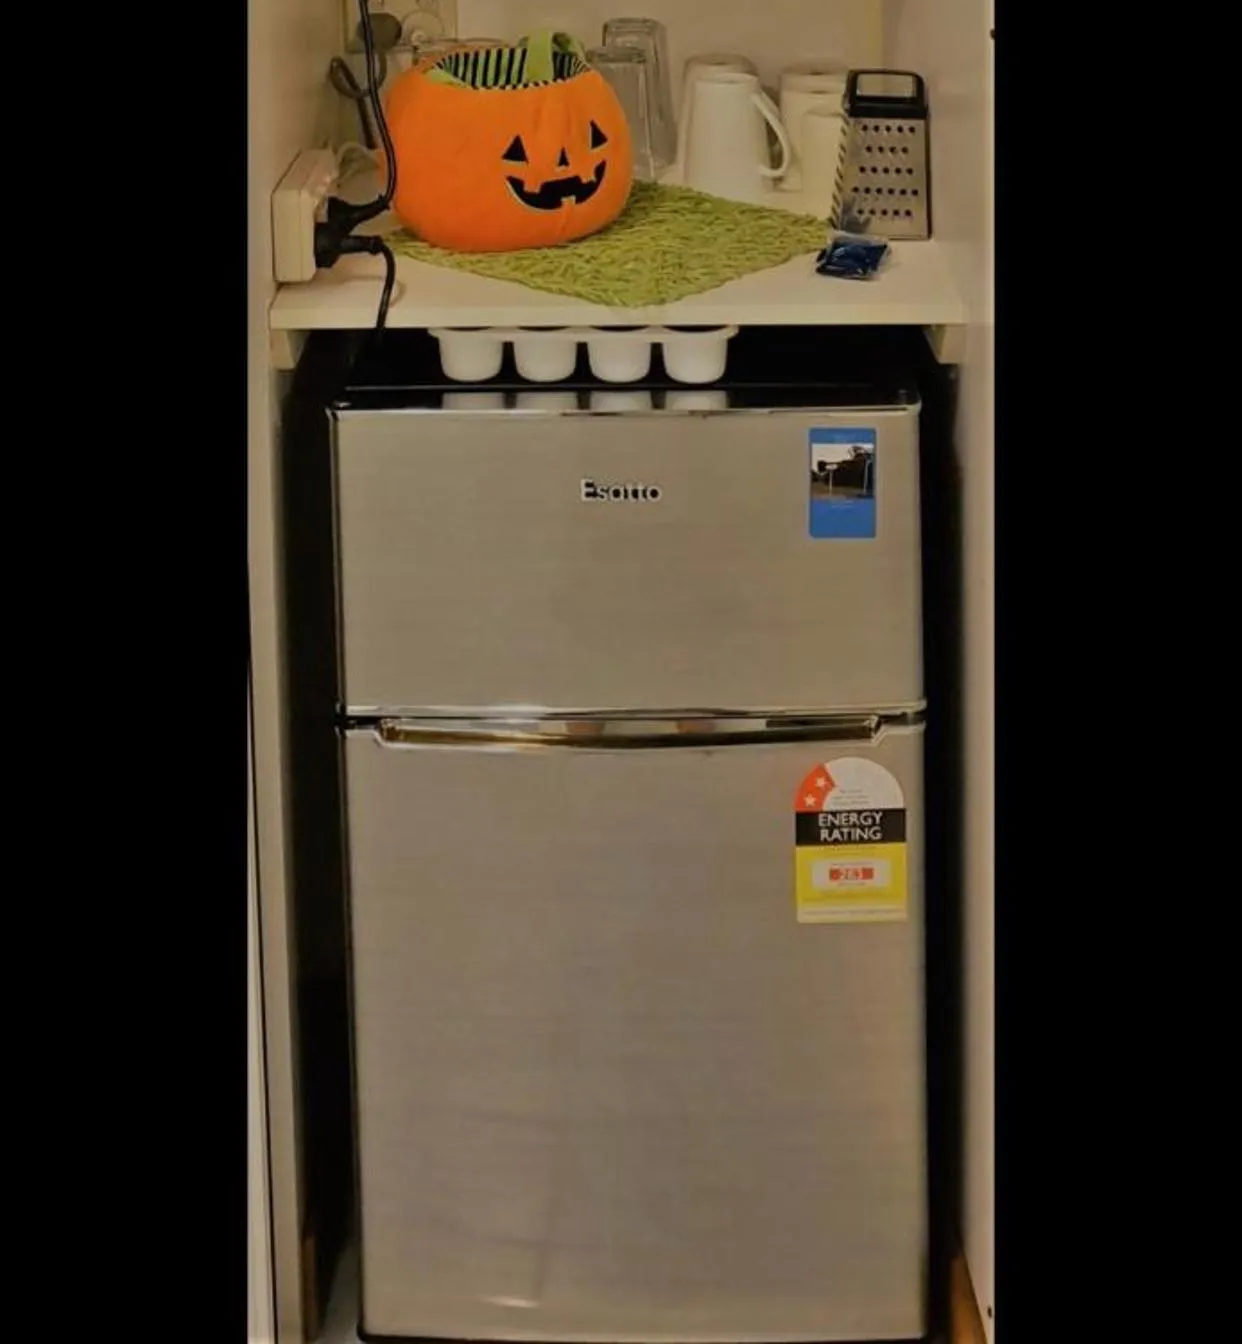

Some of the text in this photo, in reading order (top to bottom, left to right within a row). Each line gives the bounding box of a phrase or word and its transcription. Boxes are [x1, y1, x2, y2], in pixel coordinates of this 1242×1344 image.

[580, 479, 663, 503] Esatto
[818, 811, 883, 827] ENERGY
[820, 826, 883, 842] RATING
